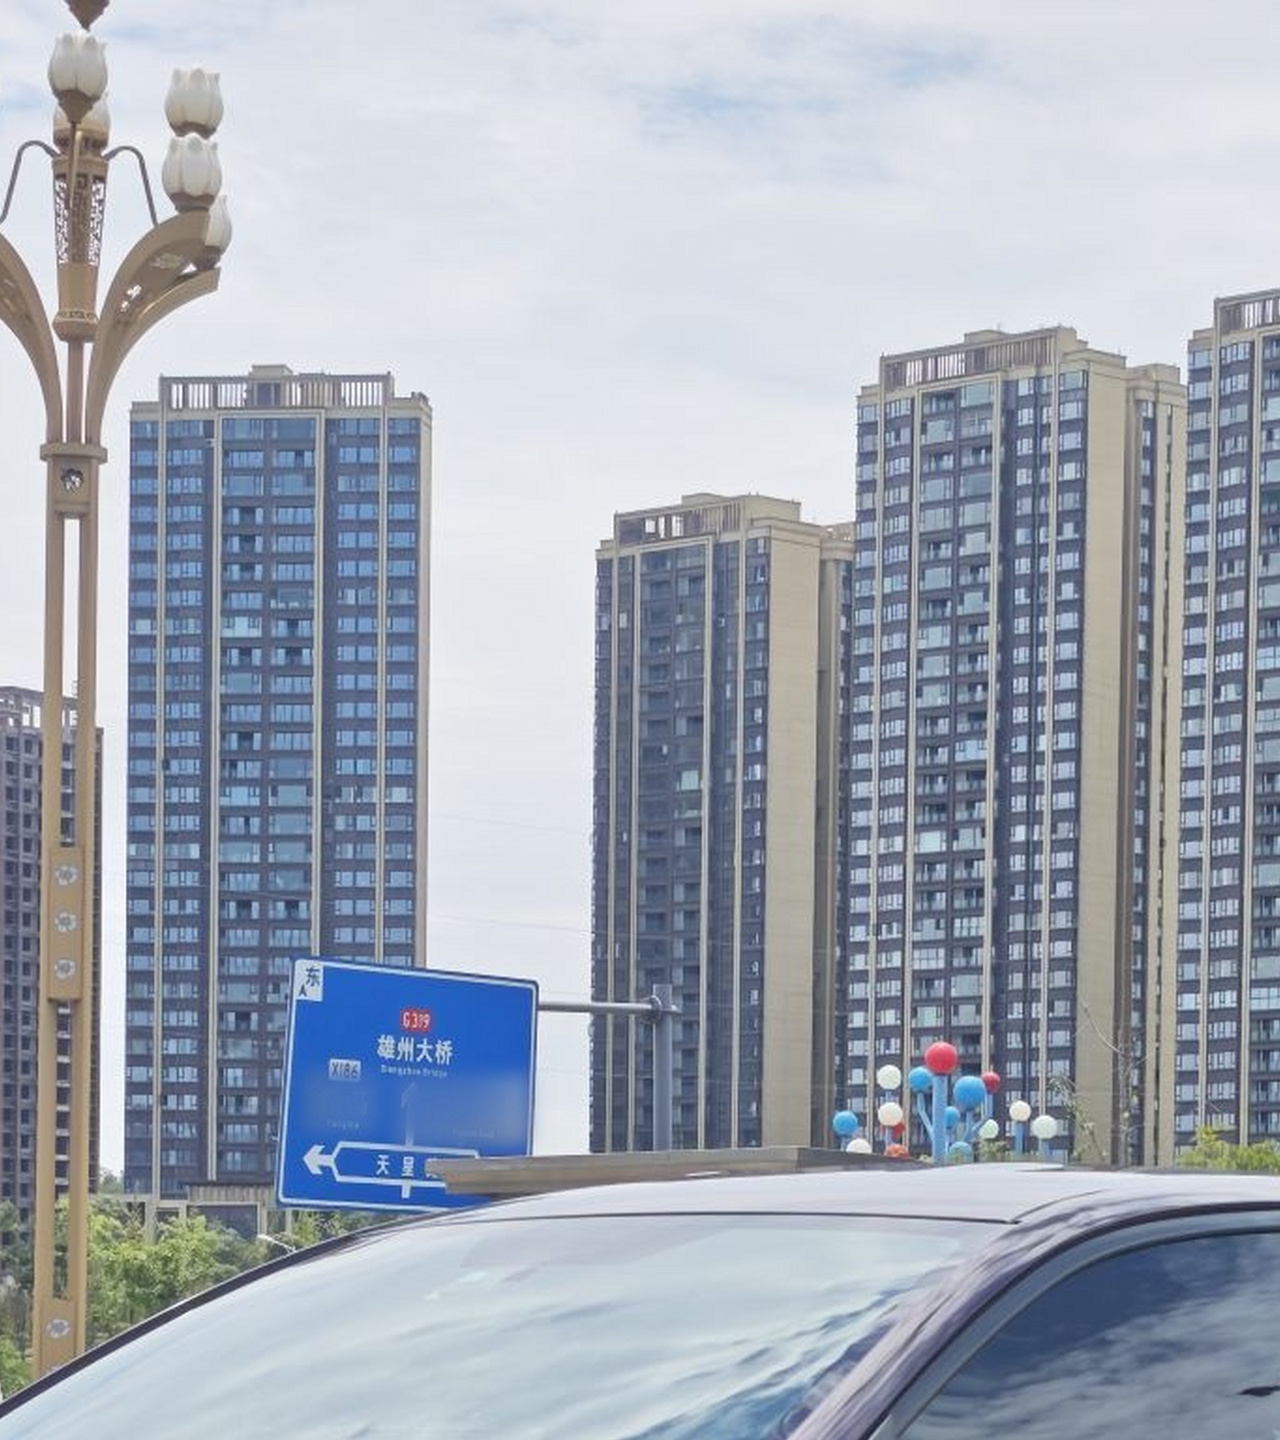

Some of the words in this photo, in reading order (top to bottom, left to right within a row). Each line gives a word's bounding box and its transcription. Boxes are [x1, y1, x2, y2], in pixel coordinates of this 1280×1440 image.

[305, 966, 320, 987] 东
[376, 1034, 453, 1066] 雄州大桥
